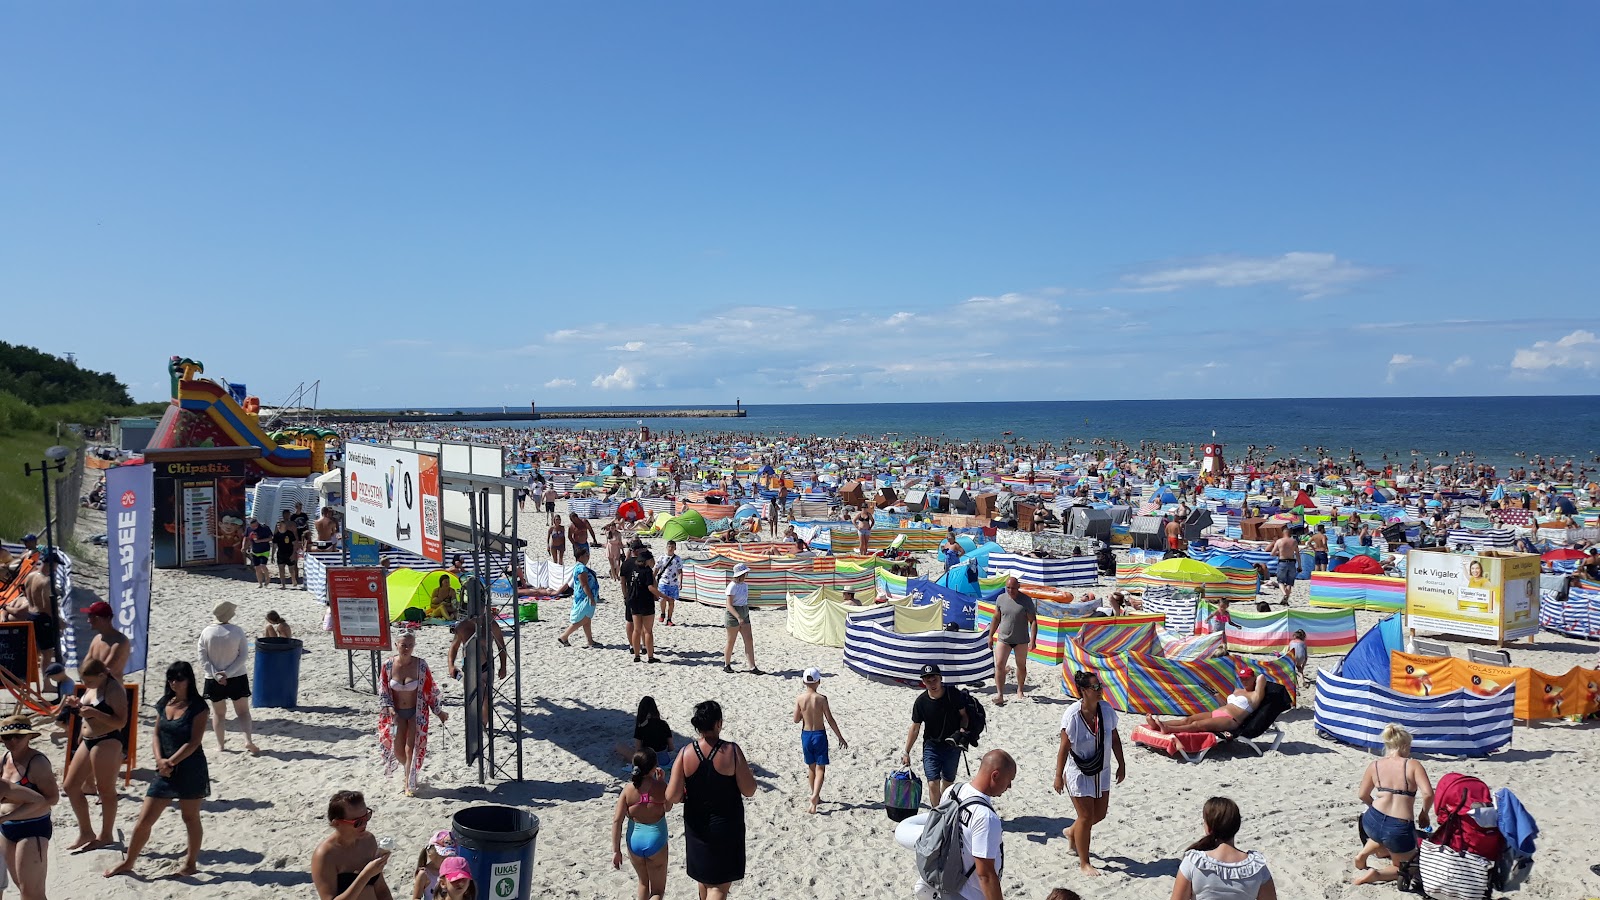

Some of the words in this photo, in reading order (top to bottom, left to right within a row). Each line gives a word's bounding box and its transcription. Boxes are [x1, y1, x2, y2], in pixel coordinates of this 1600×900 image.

[168, 463, 230, 474] Chipstix
[1430, 569, 1458, 578] Vigalex
[1418, 586, 1446, 595] witaminę
[1468, 664, 1510, 675] KOLASTYNA
[494, 864, 518, 876] LUKAS
